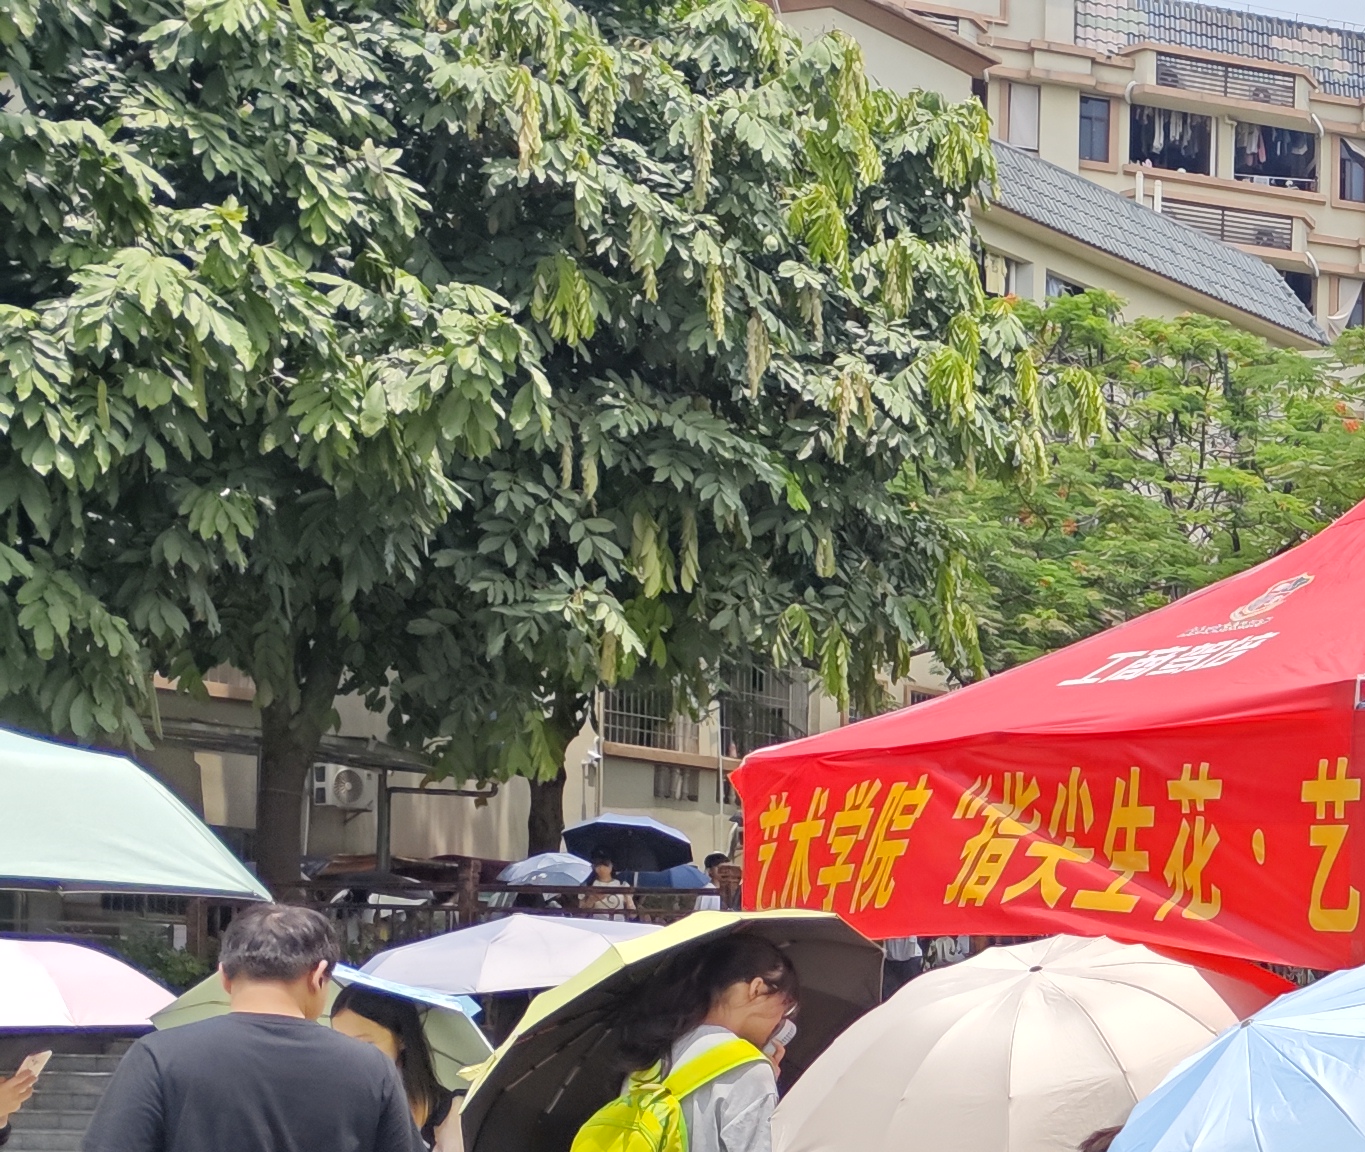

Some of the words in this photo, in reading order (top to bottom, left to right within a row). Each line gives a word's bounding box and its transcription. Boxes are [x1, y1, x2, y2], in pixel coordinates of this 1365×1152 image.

[1056, 632, 1280, 686] 工商驾培
[757, 774, 933, 910] 艺术学院
